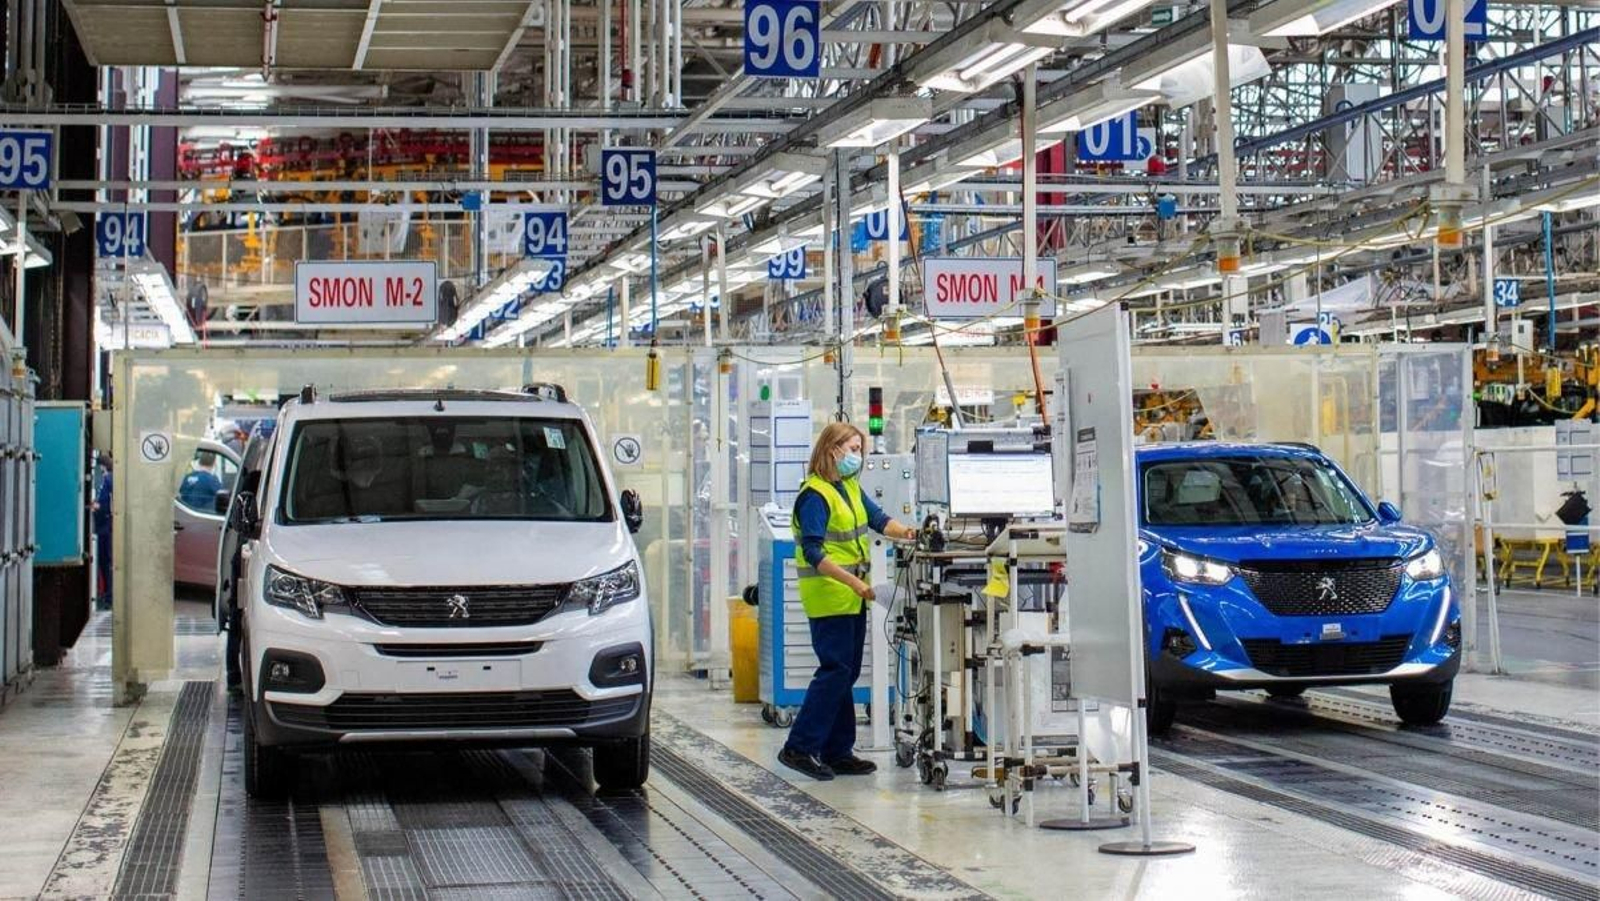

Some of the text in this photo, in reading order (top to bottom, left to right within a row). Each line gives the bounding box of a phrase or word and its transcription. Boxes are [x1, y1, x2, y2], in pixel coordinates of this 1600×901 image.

[748, 4, 815, 70] 96
[0, 137, 47, 185] 95
[606, 153, 652, 200] 95
[104, 215, 140, 253] 94
[527, 216, 566, 254] 94
[771, 248, 804, 277] 99
[309, 277, 423, 307] SMON M-2
[936, 273, 998, 302] SMON
[1496, 280, 1518, 305] 34
